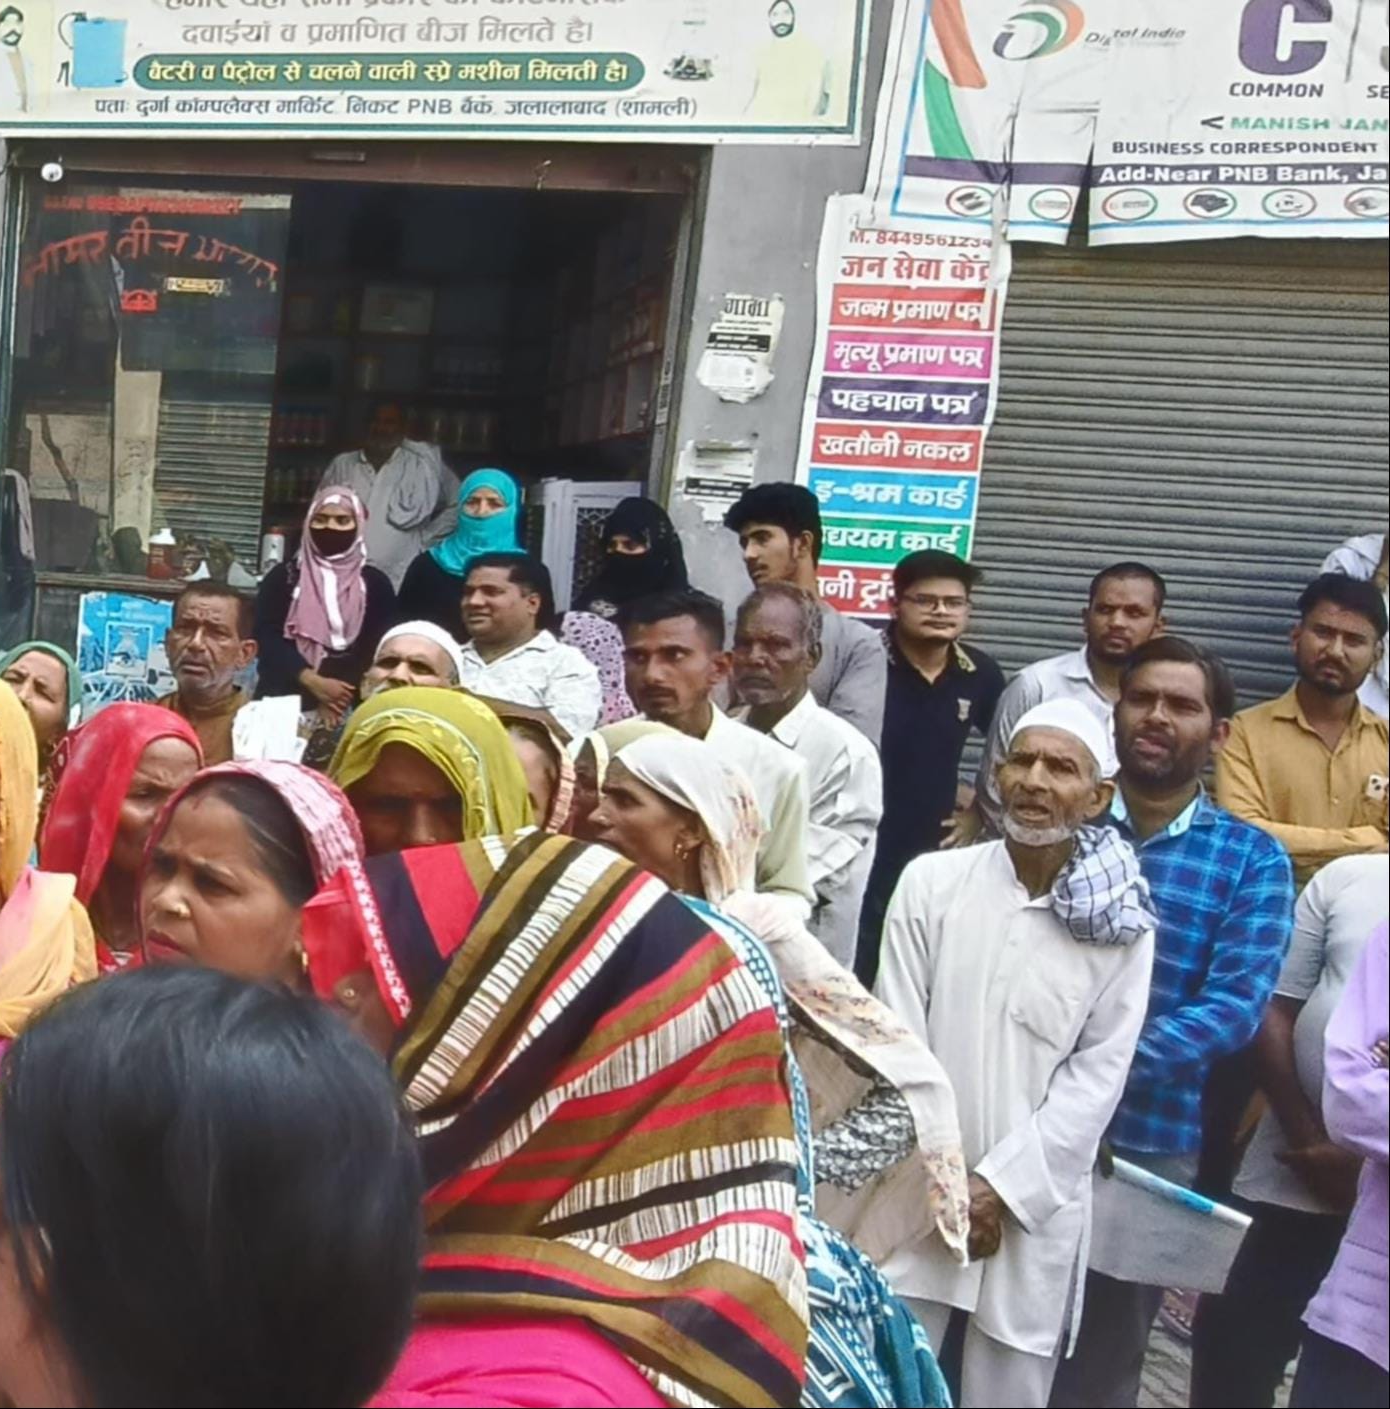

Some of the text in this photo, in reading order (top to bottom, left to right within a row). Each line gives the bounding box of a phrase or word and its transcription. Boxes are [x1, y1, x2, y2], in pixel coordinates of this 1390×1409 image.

[281, 23, 297, 42] व
[308, 16, 406, 45] प्रमाणित
[417, 16, 469, 43] बीज
[478, 15, 556, 43] मिलते
[1141, 27, 1187, 39] India
[148, 58, 195, 82] बैटरी
[202, 63, 215, 81] व
[222, 58, 277, 85] पैट्रोल
[283, 59, 302, 82] से
[309, 59, 362, 82] चलने
[369, 58, 417, 82] वाली
[424, 59, 452, 83] स्प्रे
[458, 60, 520, 82] मशीन
[527, 57, 598, 82] मिलती
[1229, 82, 1324, 98] COMMON
[136, 96, 170, 117] दुर्गा
[346, 95, 400, 115] निकट
[407, 98, 452, 115] PNB
[504, 98, 607, 116] जलालाबाद
[615, 97, 698, 119] (शामली)
[1230, 116, 1330, 130] MANISH
[1112, 141, 1377, 155] BUSINESS CORRESPONDENT
[1099, 166, 1211, 183] Add-Near
[1218, 166, 1268, 182] PNB
[1276, 166, 1349, 185] Bank,
[841, 256, 888, 278] जन
[893, 251, 944, 280] सेवा
[839, 297, 984, 324] जन्म प्रमाण पत्र
[883, 343, 947, 366] प्रमाण
[949, 346, 985, 369] पत्र
[831, 389, 974, 414] पहचान पत्र
[903, 440, 974, 462] नकल
[907, 480, 969, 509] कार्ड
[900, 526, 962, 554] कार्ड
